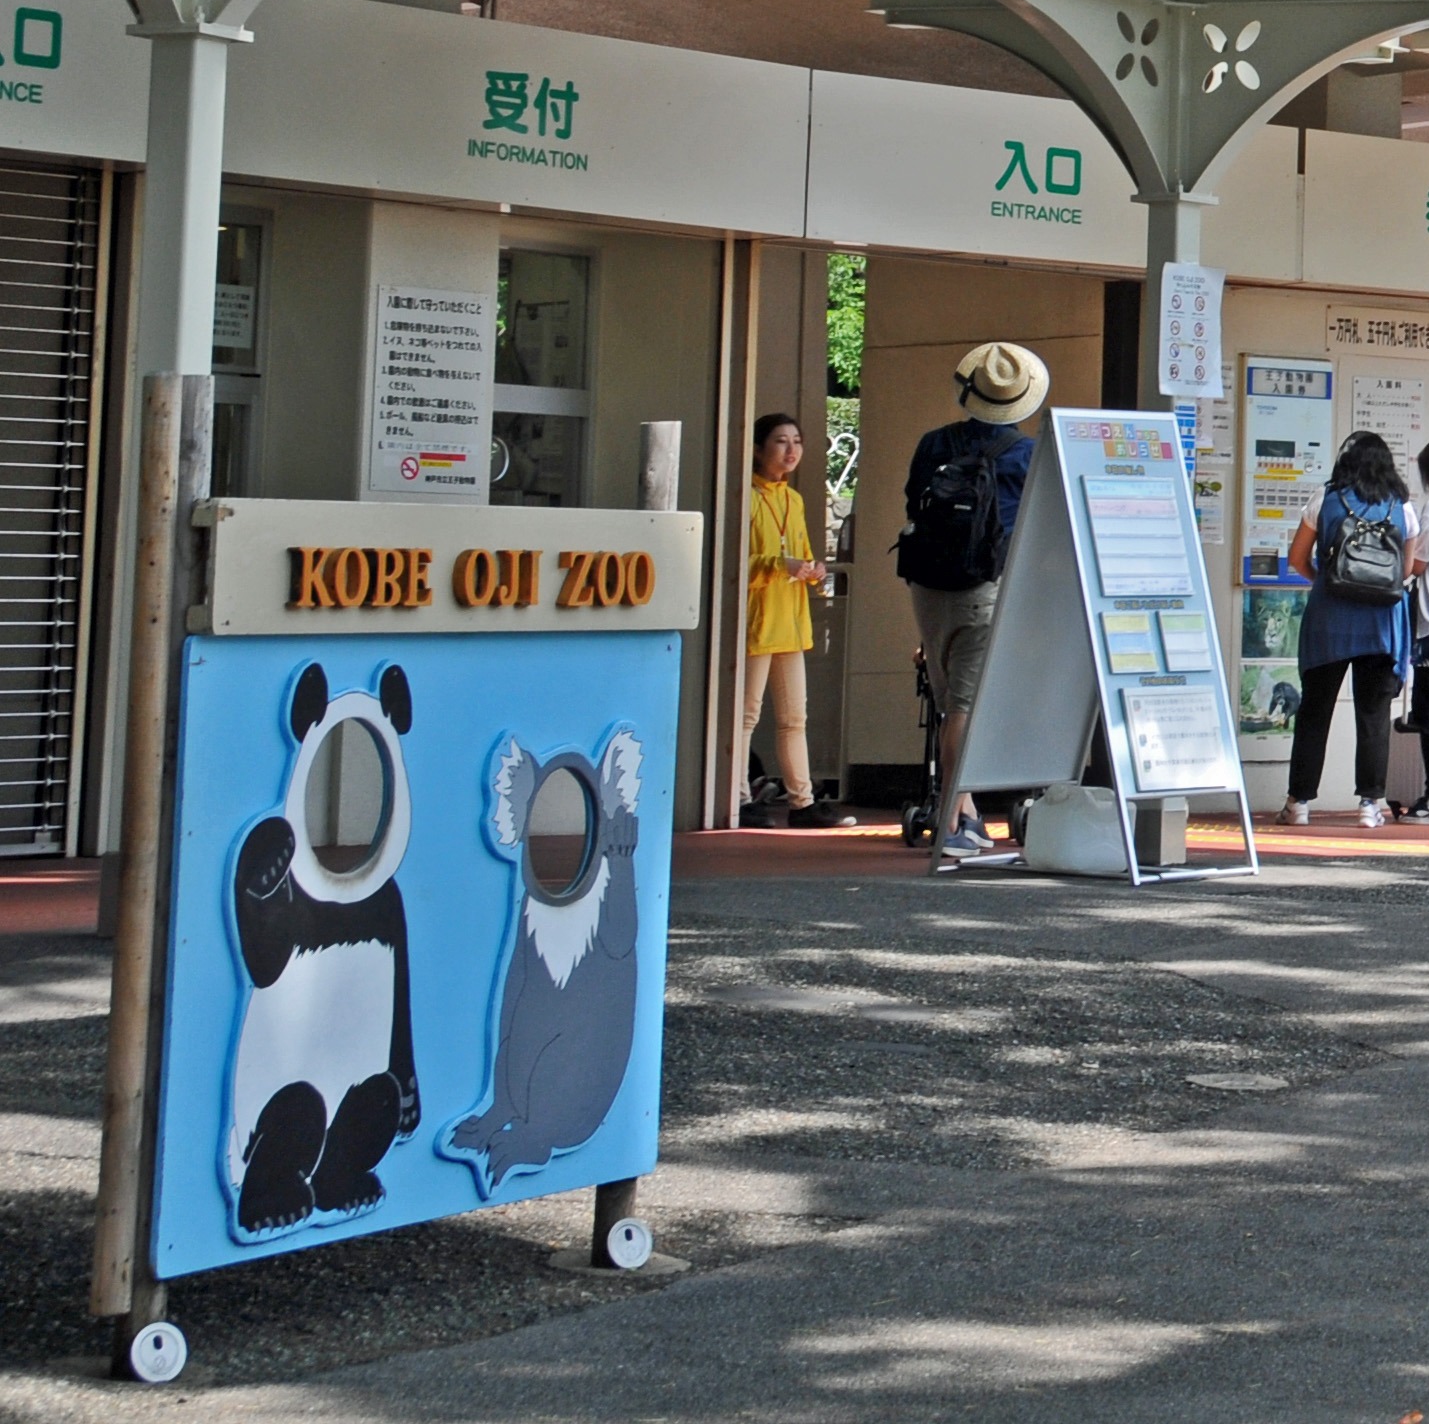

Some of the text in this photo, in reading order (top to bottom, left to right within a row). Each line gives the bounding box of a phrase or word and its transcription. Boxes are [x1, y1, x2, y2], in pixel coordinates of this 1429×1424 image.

[0, 7, 62, 69] 口
[483, 71, 579, 140] 受付
[467, 139, 588, 171] INFORMATION
[995, 141, 1081, 196] 入口
[991, 201, 1082, 225] ENTRANCE
[290, 546, 656, 610] KOBE OJI ZOO
